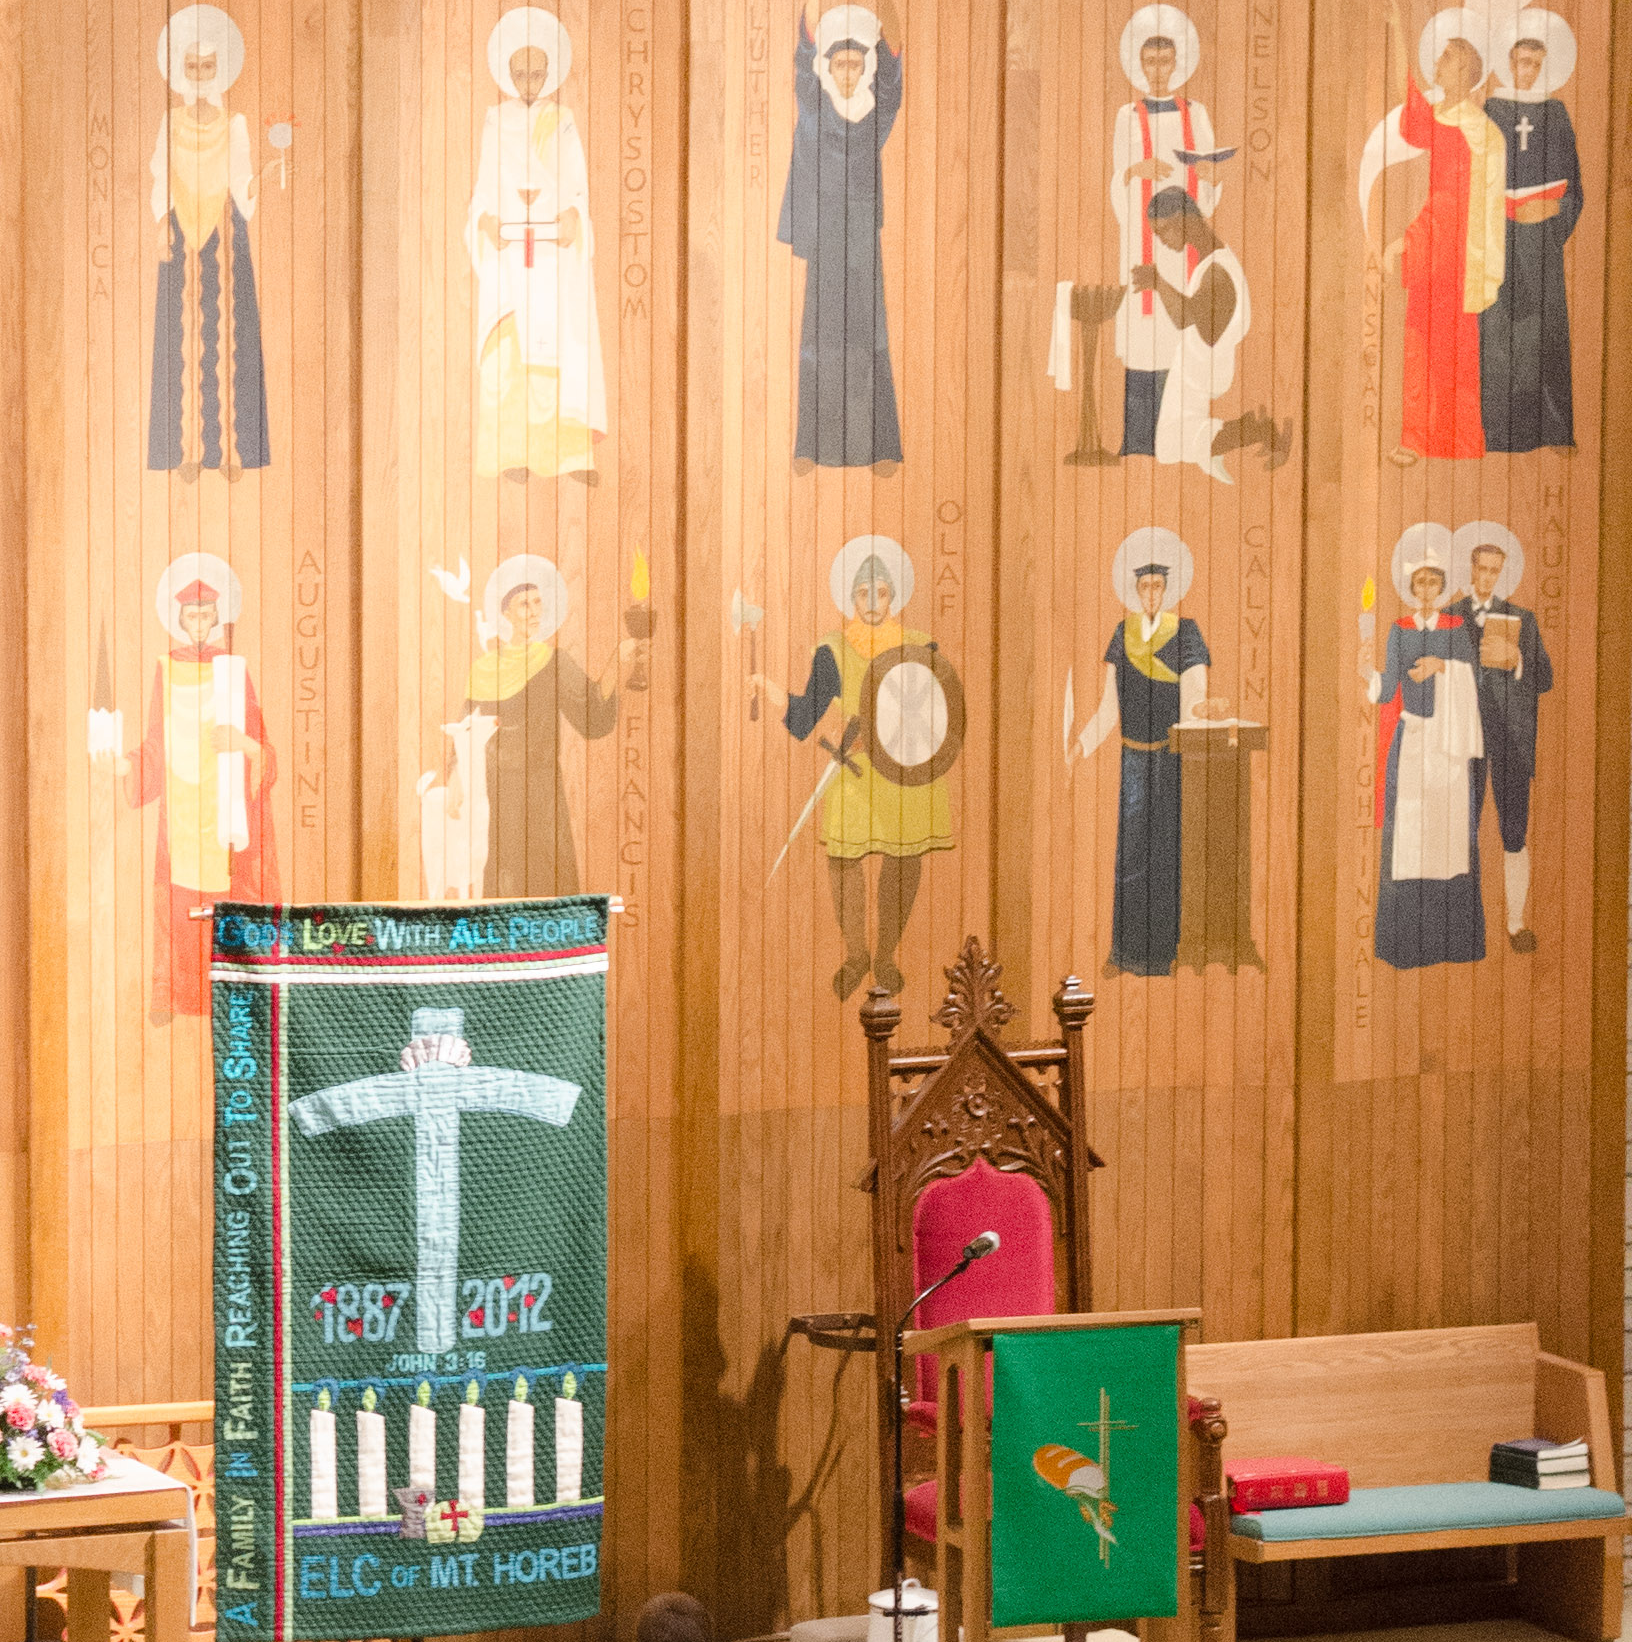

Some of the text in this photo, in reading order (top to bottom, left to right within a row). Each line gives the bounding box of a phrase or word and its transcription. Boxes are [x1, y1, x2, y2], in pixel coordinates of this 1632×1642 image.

[749, 8, 767, 188] LUTHER
[1249, 7, 1273, 182] NELSON
[90, 114, 110, 301] MONICA
[624, 9, 648, 318] CHRYSOSTOM
[1362, 253, 1382, 428] ANSGAR
[936, 501, 963, 617] OLAF
[1243, 525, 1268, 701] CALVIN
[1541, 485, 1565, 629] HAUGE
[297, 551, 323, 829] AUGUSTINE
[621, 717, 648, 928] FRANCIS
[1353, 707, 1375, 1030] NIGHTINGALE
[303, 918, 368, 950] LOVE
[374, 917, 440, 950] WITH
[448, 917, 501, 950] ALL
[508, 916, 598, 950] PEOPLE
[223, 990, 258, 1080] SHARE
[224, 1090, 258, 1127] TO
[225, 1210, 258, 1348] REACHING
[310, 1272, 553, 1343] 1887 2012
[223, 1362, 258, 1440] FAITH
[386, 1351, 487, 1372] JOHN 3:16
[225, 1452, 258, 1477] IN
[226, 1495, 260, 1590] FAMILY
[300, 1553, 382, 1599] ELC
[430, 1553, 480, 1588] MT.
[493, 1543, 597, 1584] HOREB
[225, 1602, 258, 1627] A
